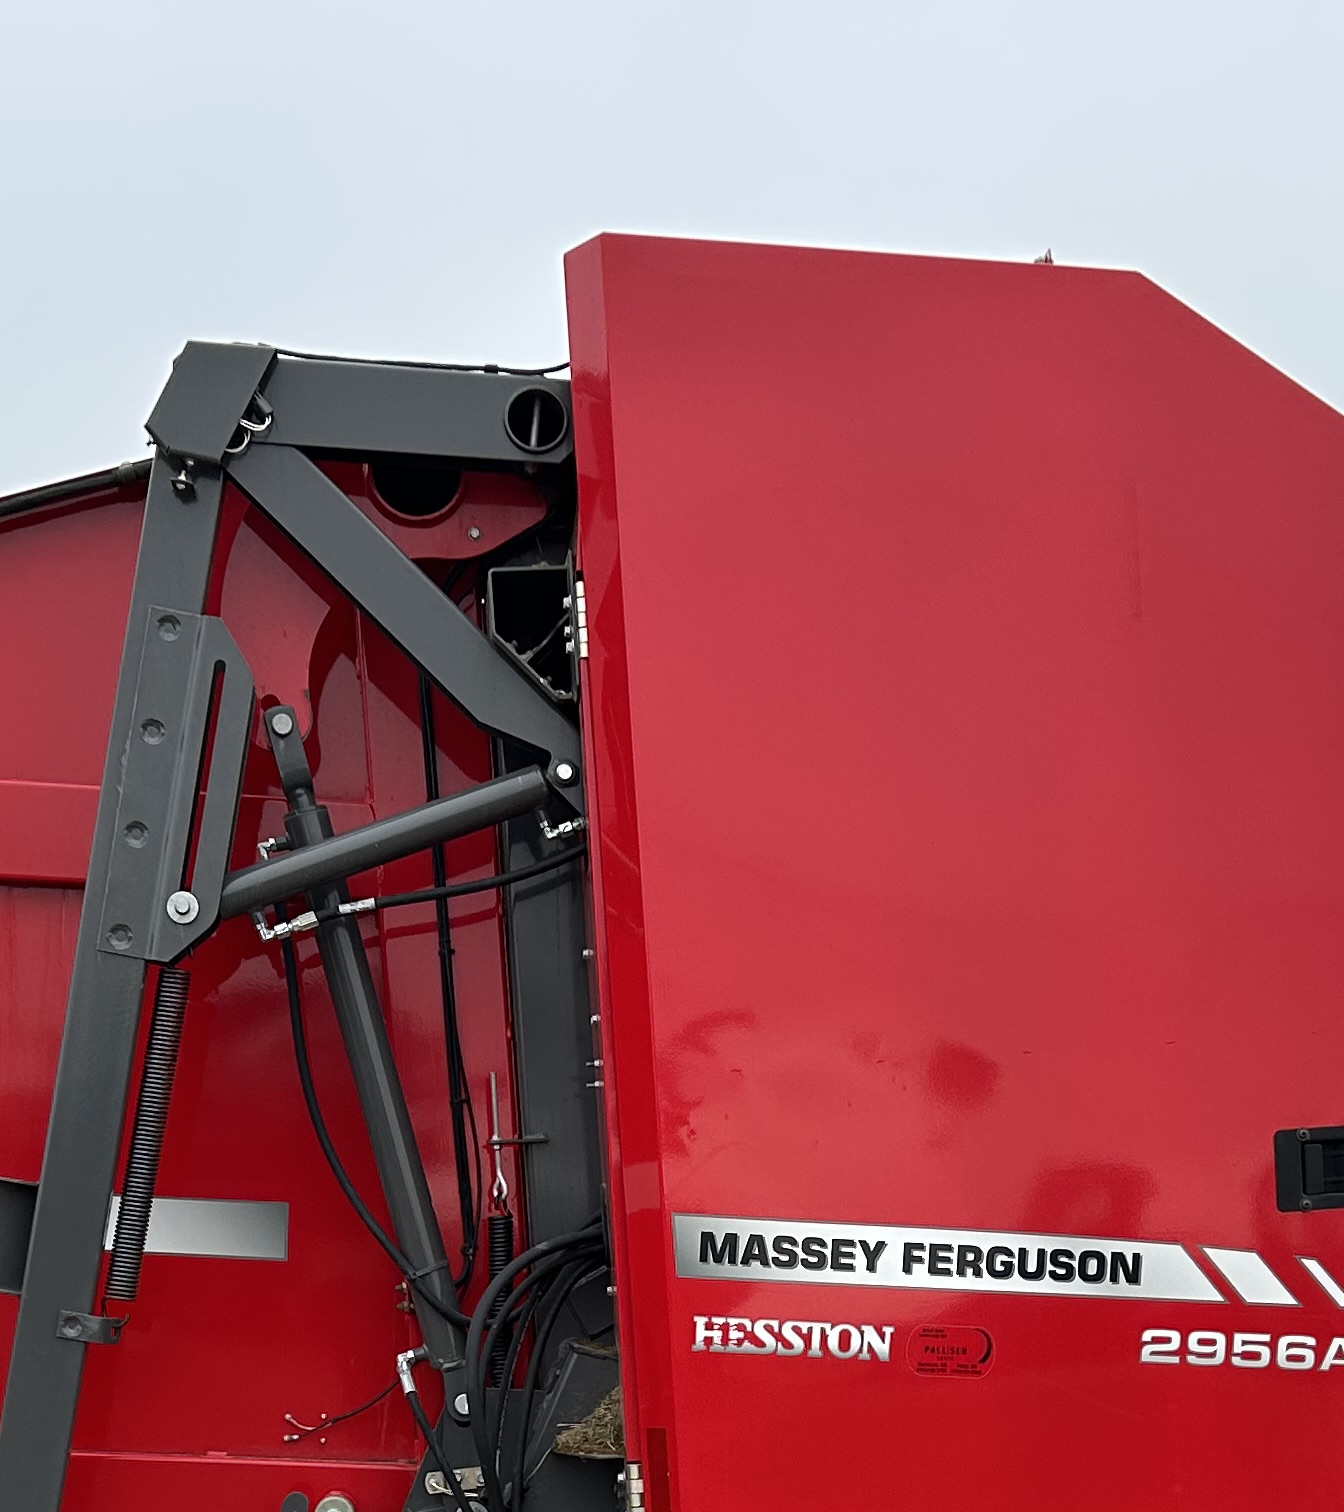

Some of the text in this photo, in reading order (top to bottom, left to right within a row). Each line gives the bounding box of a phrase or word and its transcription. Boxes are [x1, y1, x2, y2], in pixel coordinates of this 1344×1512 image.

[698, 1231, 1142, 1286] MASSEY FERGUSON
[691, 1315, 895, 1363] HESSTON
